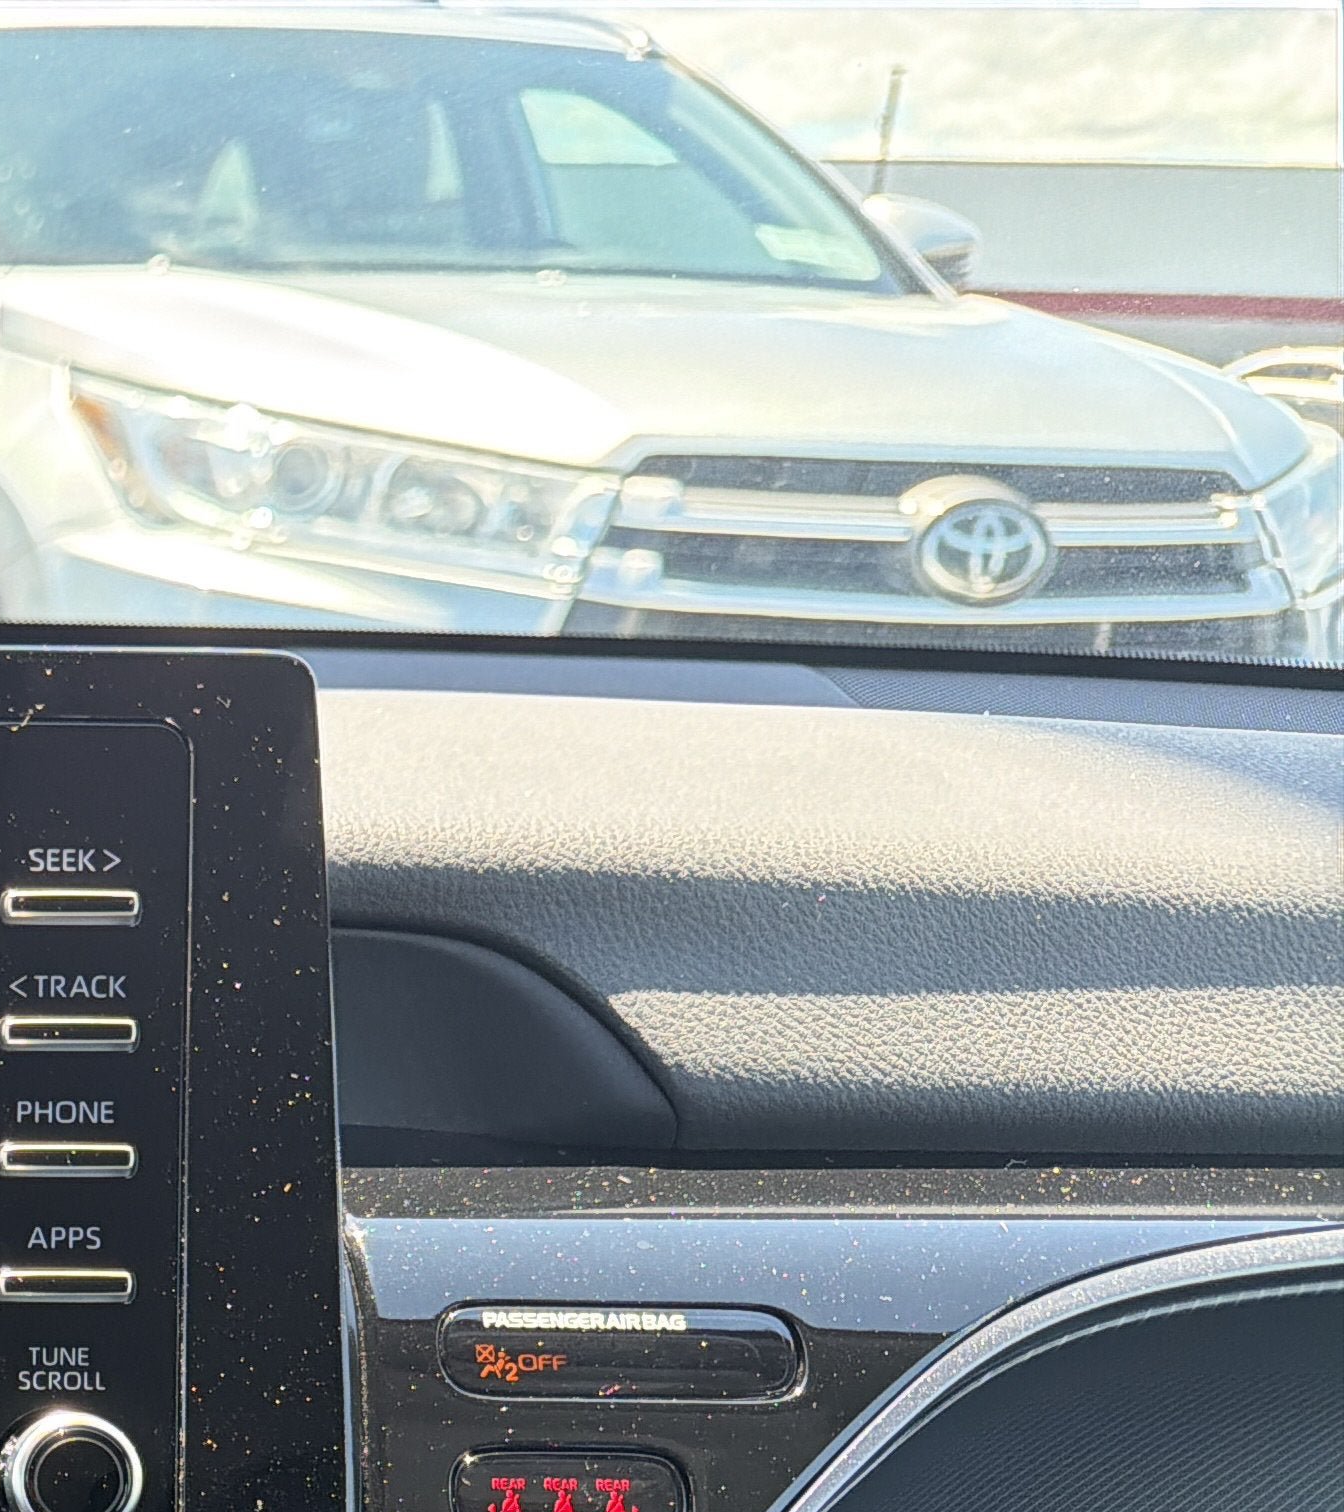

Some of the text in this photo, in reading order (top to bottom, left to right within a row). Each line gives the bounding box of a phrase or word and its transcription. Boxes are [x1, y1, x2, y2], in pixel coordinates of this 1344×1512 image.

[29, 848, 95, 872] SEEK
[34, 975, 126, 999] TRACK
[16, 1100, 115, 1125] PHONE
[27, 1226, 102, 1250] APPS
[482, 1311, 605, 1329] PASSENGER
[29, 1347, 89, 1367] TUNE
[518, 1354, 566, 1371] OFF
[18, 1371, 106, 1391] SCROLL
[491, 1478, 526, 1490] REAR
[543, 1478, 578, 1490] REAR
[595, 1478, 630, 1490] REAR
